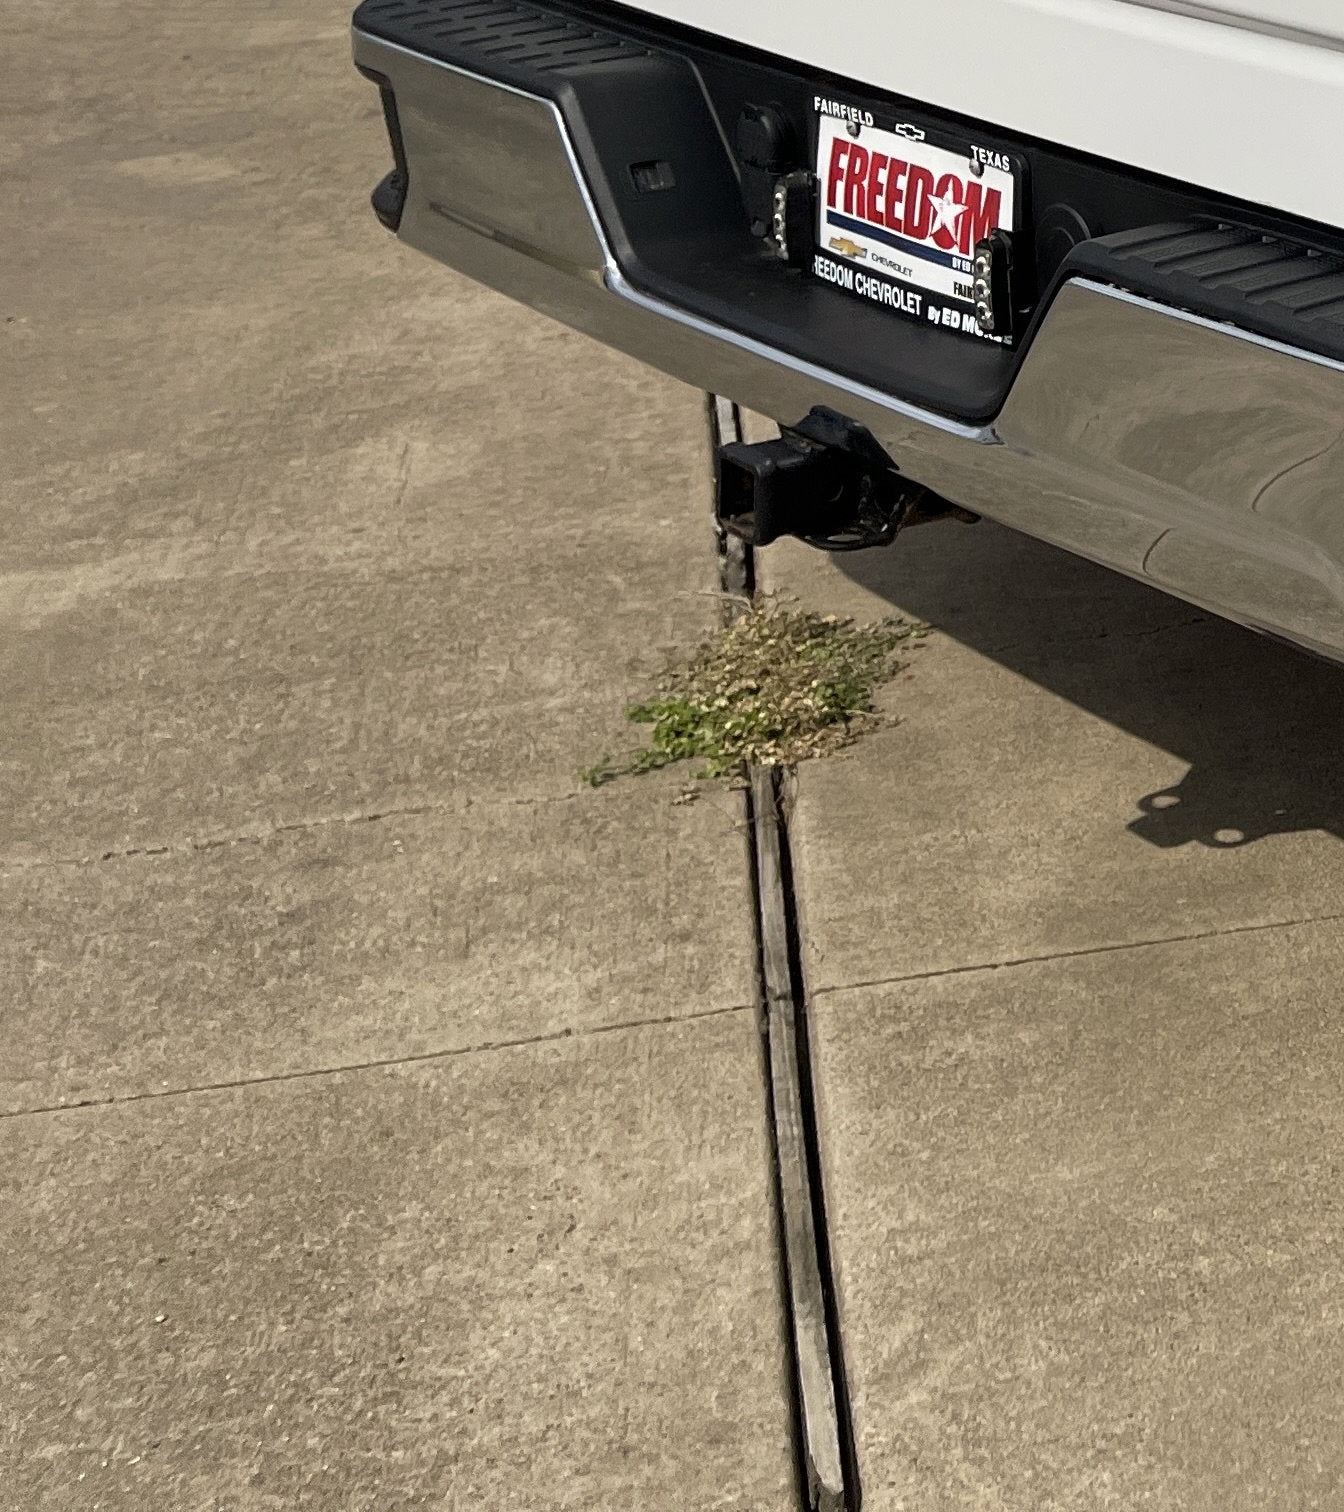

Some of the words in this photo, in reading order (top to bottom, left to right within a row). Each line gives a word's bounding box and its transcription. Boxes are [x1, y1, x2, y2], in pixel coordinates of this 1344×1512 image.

[814, 96, 874, 127] FAIRFIELD
[971, 145, 1010, 172] TEXAS
[826, 136, 1002, 256] FREEDOM
[871, 253, 913, 277] CHEVROLET
[855, 273, 922, 316] CHEVROLET
[942, 307, 961, 329] ED
